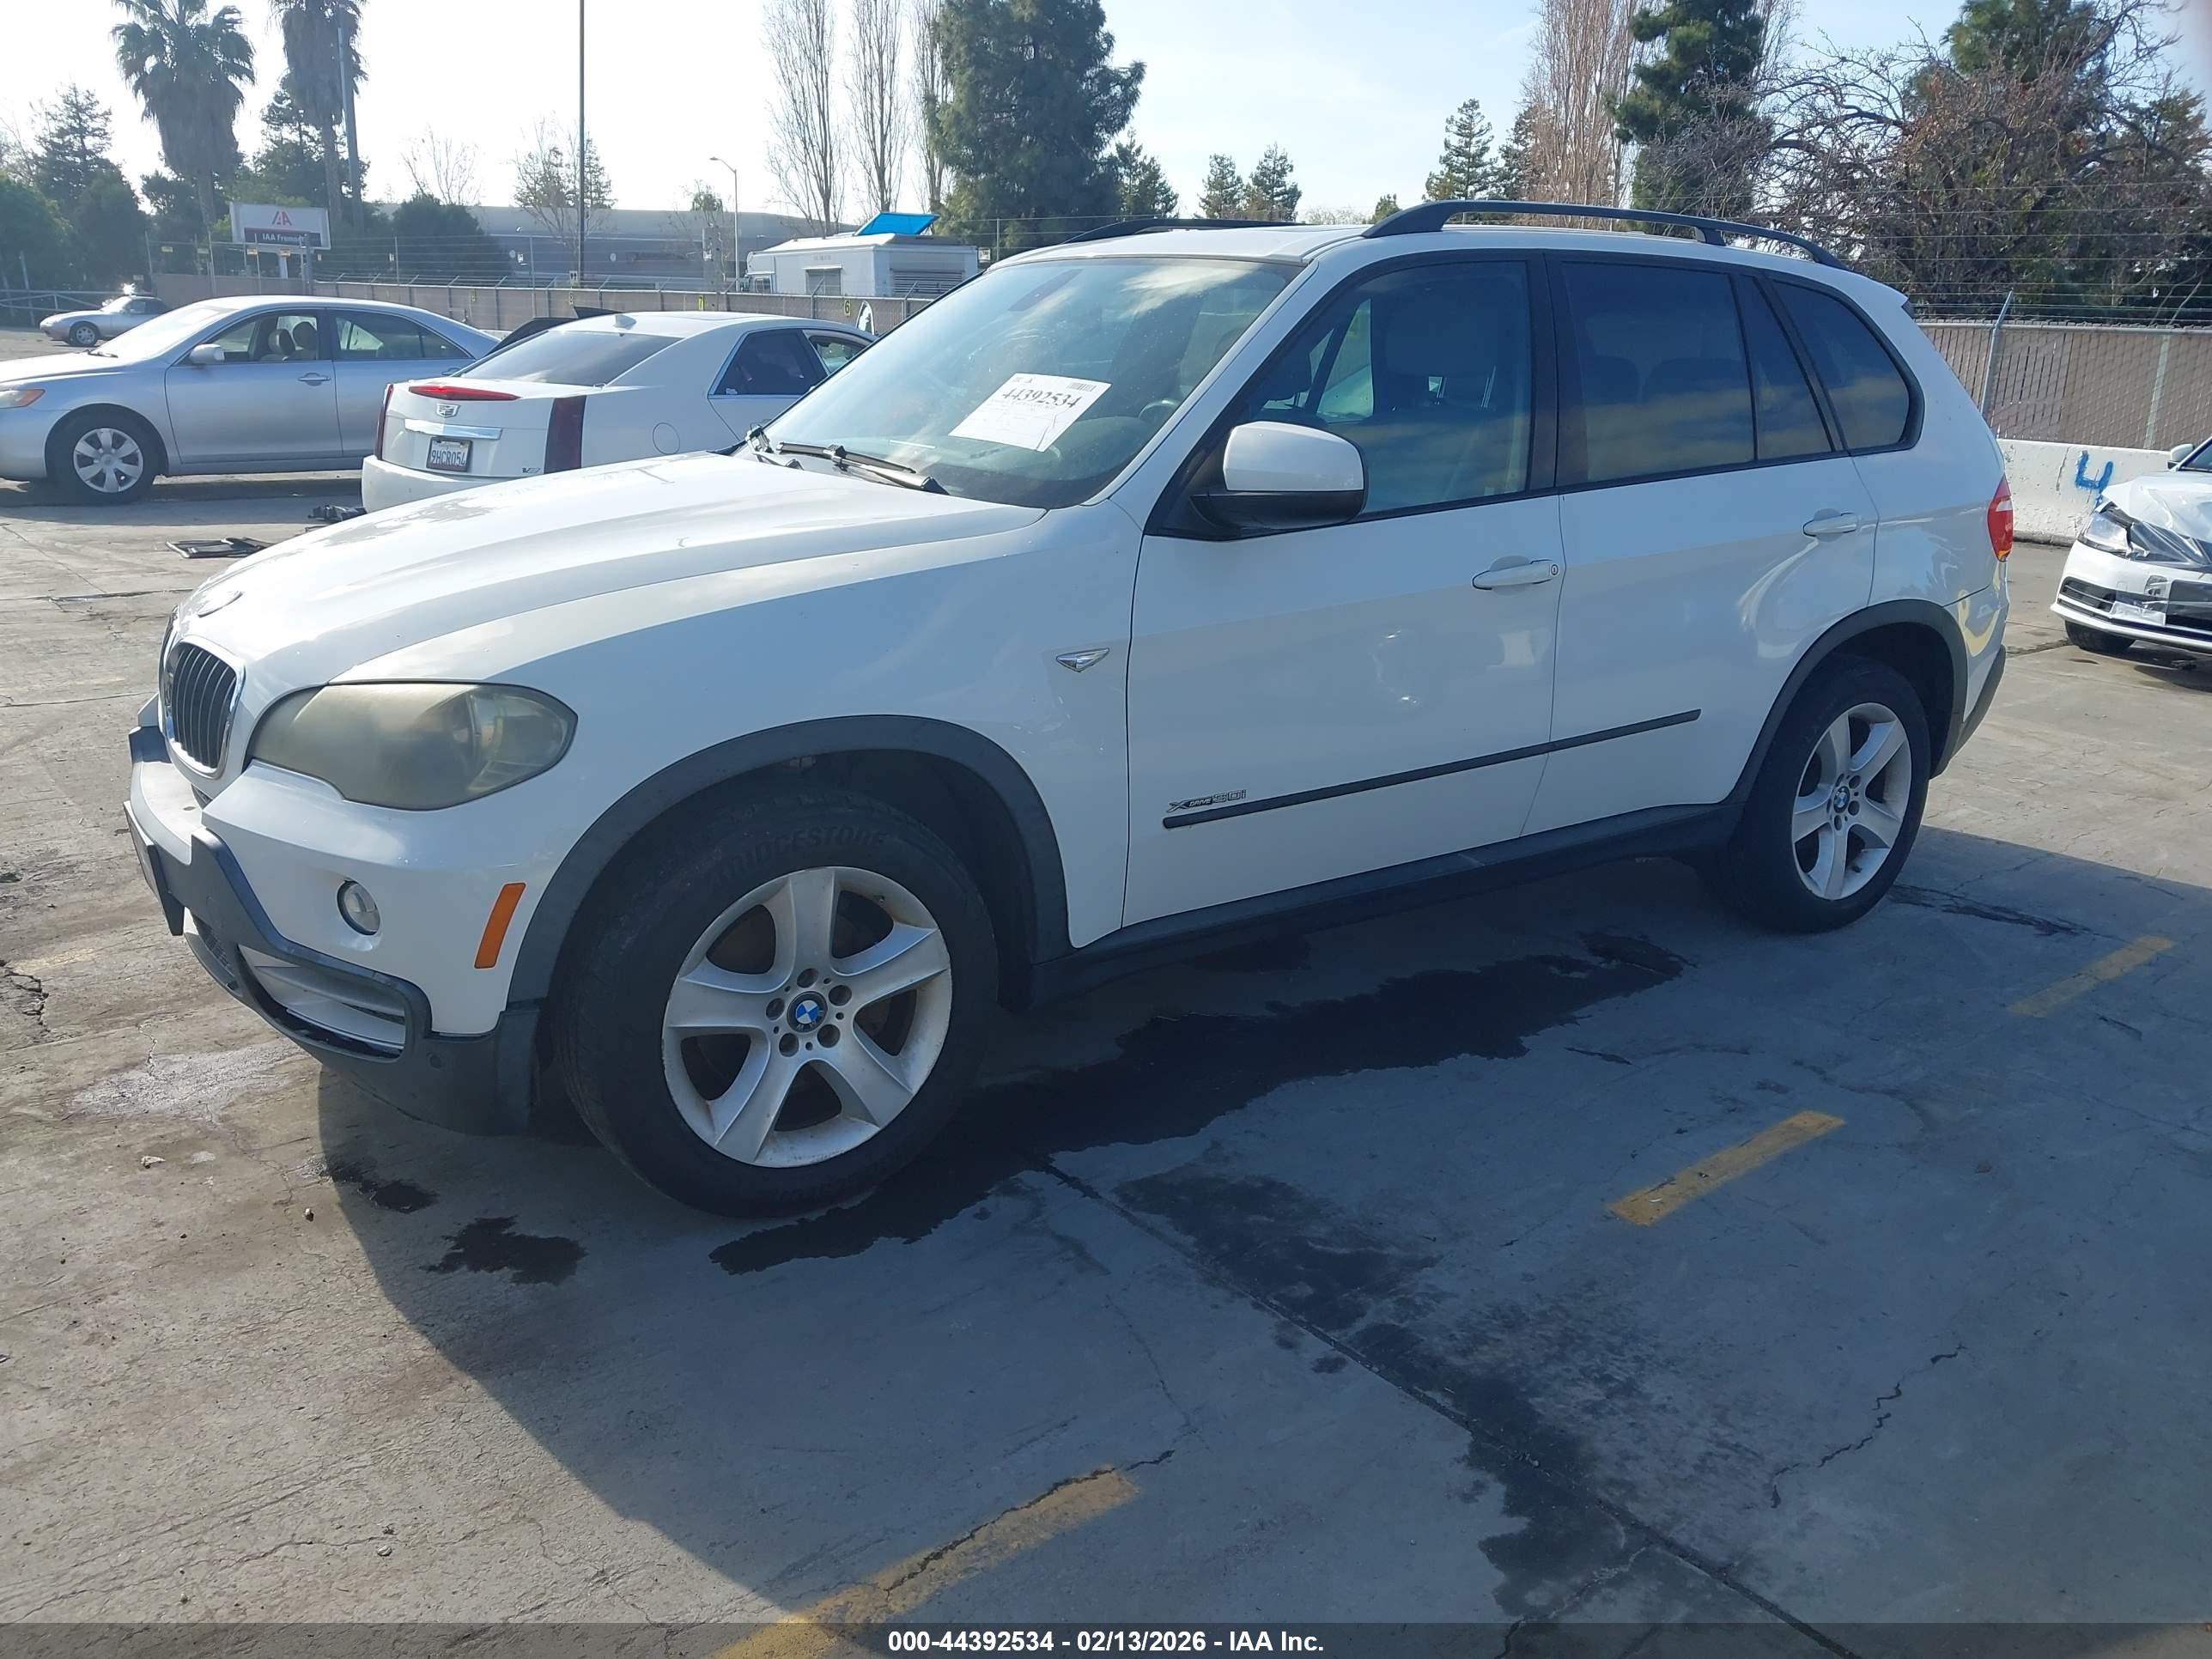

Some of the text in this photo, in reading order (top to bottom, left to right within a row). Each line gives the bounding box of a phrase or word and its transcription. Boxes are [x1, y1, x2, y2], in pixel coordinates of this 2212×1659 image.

[262, 233, 276, 241] IAA
[845, 301, 850, 314] 6
[1002, 388, 1082, 409] 44392534
[431, 449, 466, 467] 9HCR054
